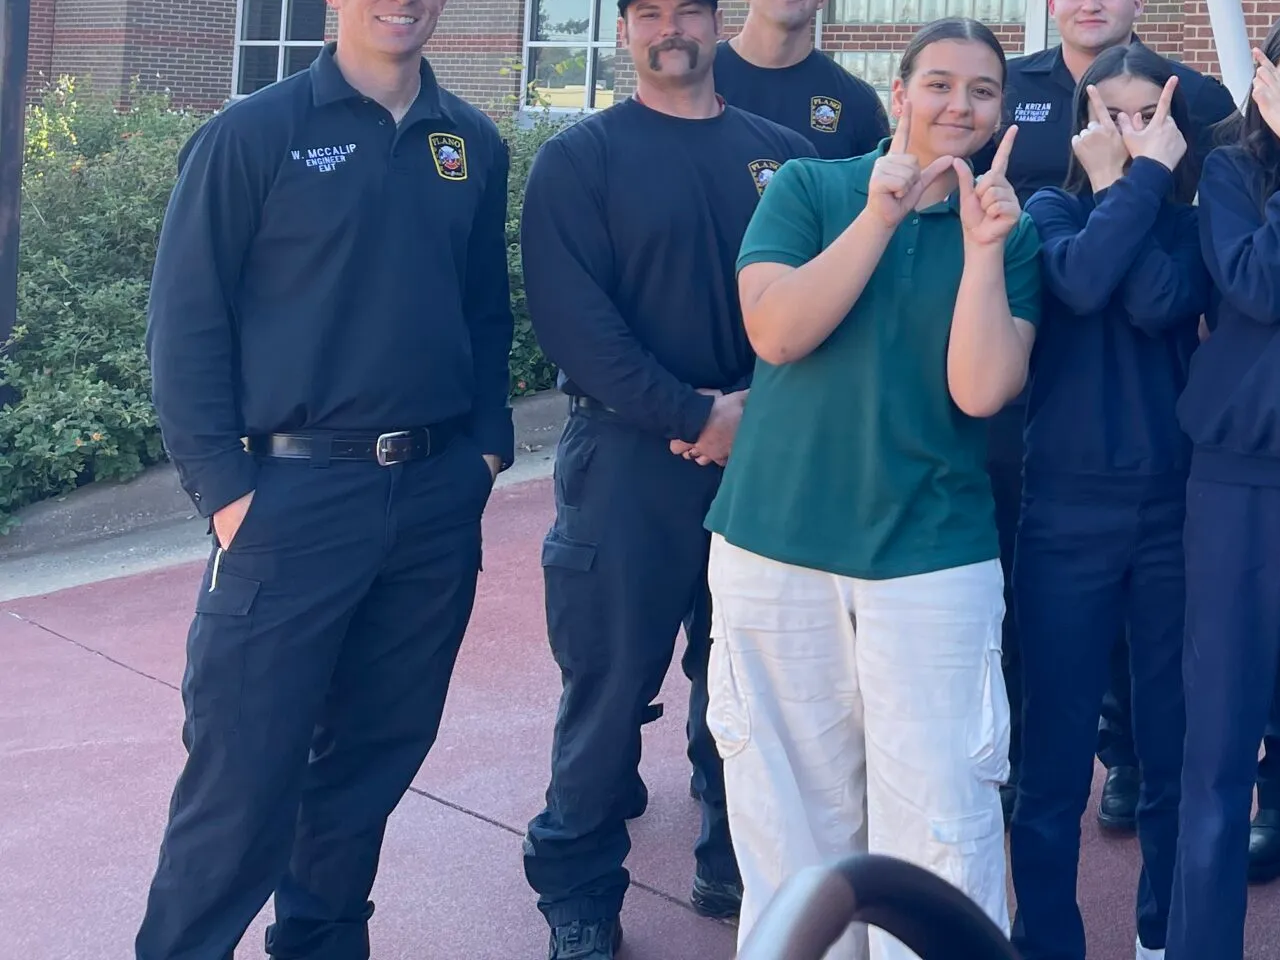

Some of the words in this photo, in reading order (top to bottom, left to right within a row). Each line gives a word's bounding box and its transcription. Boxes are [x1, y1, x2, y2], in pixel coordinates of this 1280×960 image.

[812, 98, 840, 110] PLANO
[431, 137, 461, 148] PLANO
[291, 150, 305, 160] W.
[307, 143, 357, 158] MCCALIP
[305, 155, 346, 167] ENGINEER
[750, 161, 780, 171] PLAN
